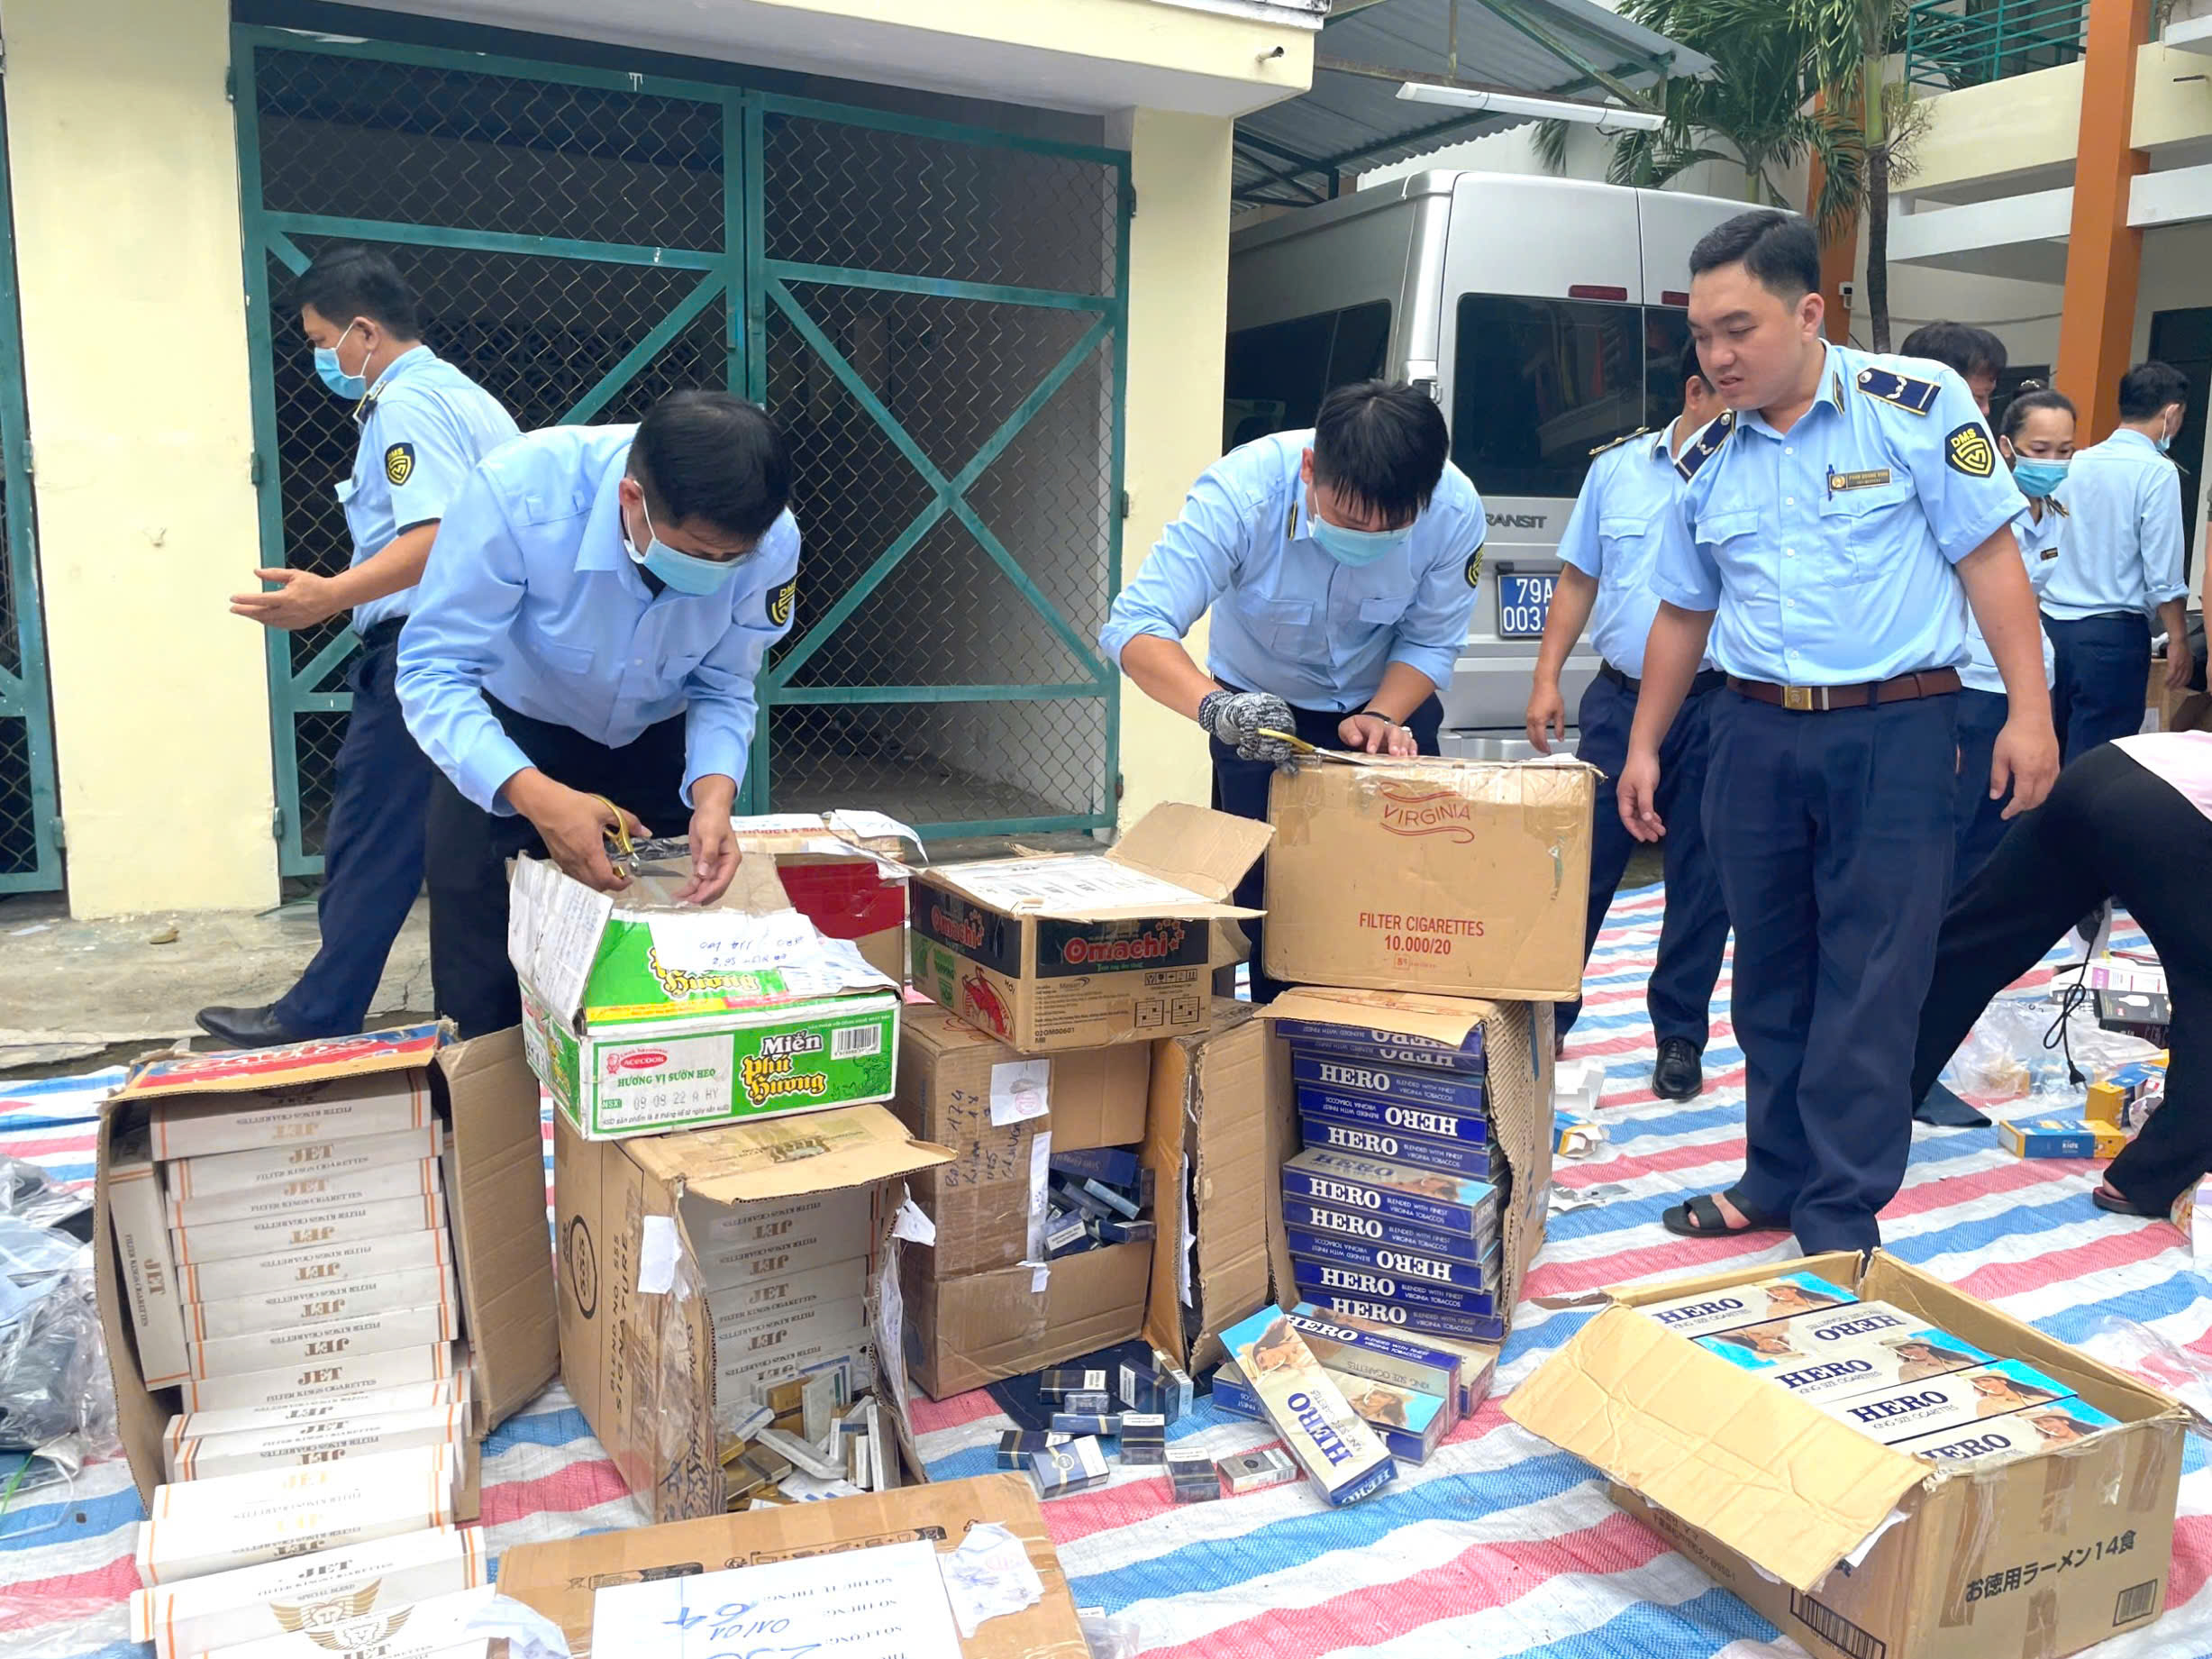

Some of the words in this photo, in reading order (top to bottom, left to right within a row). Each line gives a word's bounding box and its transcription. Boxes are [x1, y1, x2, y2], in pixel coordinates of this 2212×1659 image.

[1951, 428, 1976, 449] DMS
[1486, 513, 1547, 528] RANSIT
[1516, 579, 1552, 604] 79A
[1383, 803, 1471, 826] VIRGINIA
[1359, 912, 1402, 931] FILTER
[1406, 916, 1484, 937] CIGARETTES
[1064, 931, 1168, 964] Omachi
[1384, 934, 1452, 955] 10.000/20
[1371, 1029, 1452, 1050] ERO
[617, 1075, 652, 1087] HƯƠNG
[655, 1074, 666, 1085] VỊ
[668, 1070, 695, 1081] SƯỜN
[696, 1069, 716, 1079] HEO
[1319, 1063, 1389, 1091] HERO
[673, 1091, 686, 1105] 22
[1385, 1107, 1458, 1136] HERO
[1328, 1126, 1397, 1155] HERO
[288, 1144, 335, 1164] JET
[283, 1178, 330, 1196] JET
[1309, 1177, 1381, 1209] HERO
[1387, 1197, 1412, 1208] BLENDED
[1414, 1202, 1429, 1211] WITH
[1389, 1206, 1414, 1217] VIRGINIA
[1415, 1211, 1444, 1224] TOBACCOS
[288, 1226, 335, 1245] JET
[752, 1219, 793, 1240] JET
[1309, 1208, 1383, 1238] HERO
[144, 1258, 166, 1295] JET
[295, 1262, 341, 1281] JET
[750, 1254, 789, 1276] JET
[1377, 1250, 1452, 1281] HERO
[749, 1283, 789, 1304] JET
[1321, 1267, 1395, 1296] HERO
[300, 1299, 346, 1318] JET
[1331, 1298, 1407, 1324] HERO
[1652, 1298, 1743, 1324] HERO
[615, 1232, 629, 1414] SIGNATURE
[1286, 1313, 1359, 1343] HERO
[1815, 1314, 1907, 1341] HERO
[304, 1337, 350, 1356] JET
[748, 1329, 787, 1351] JET
[610, 1324, 618, 1392] BLEND
[297, 1366, 343, 1385] JET
[1775, 1359, 1873, 1389] HERO
[1847, 1390, 1949, 1423] HERO
[1287, 1392, 1353, 1467] HERO
[1920, 1434, 2012, 1461] ERO
[1965, 1530, 2136, 1603] お徳用ラーメン14食
